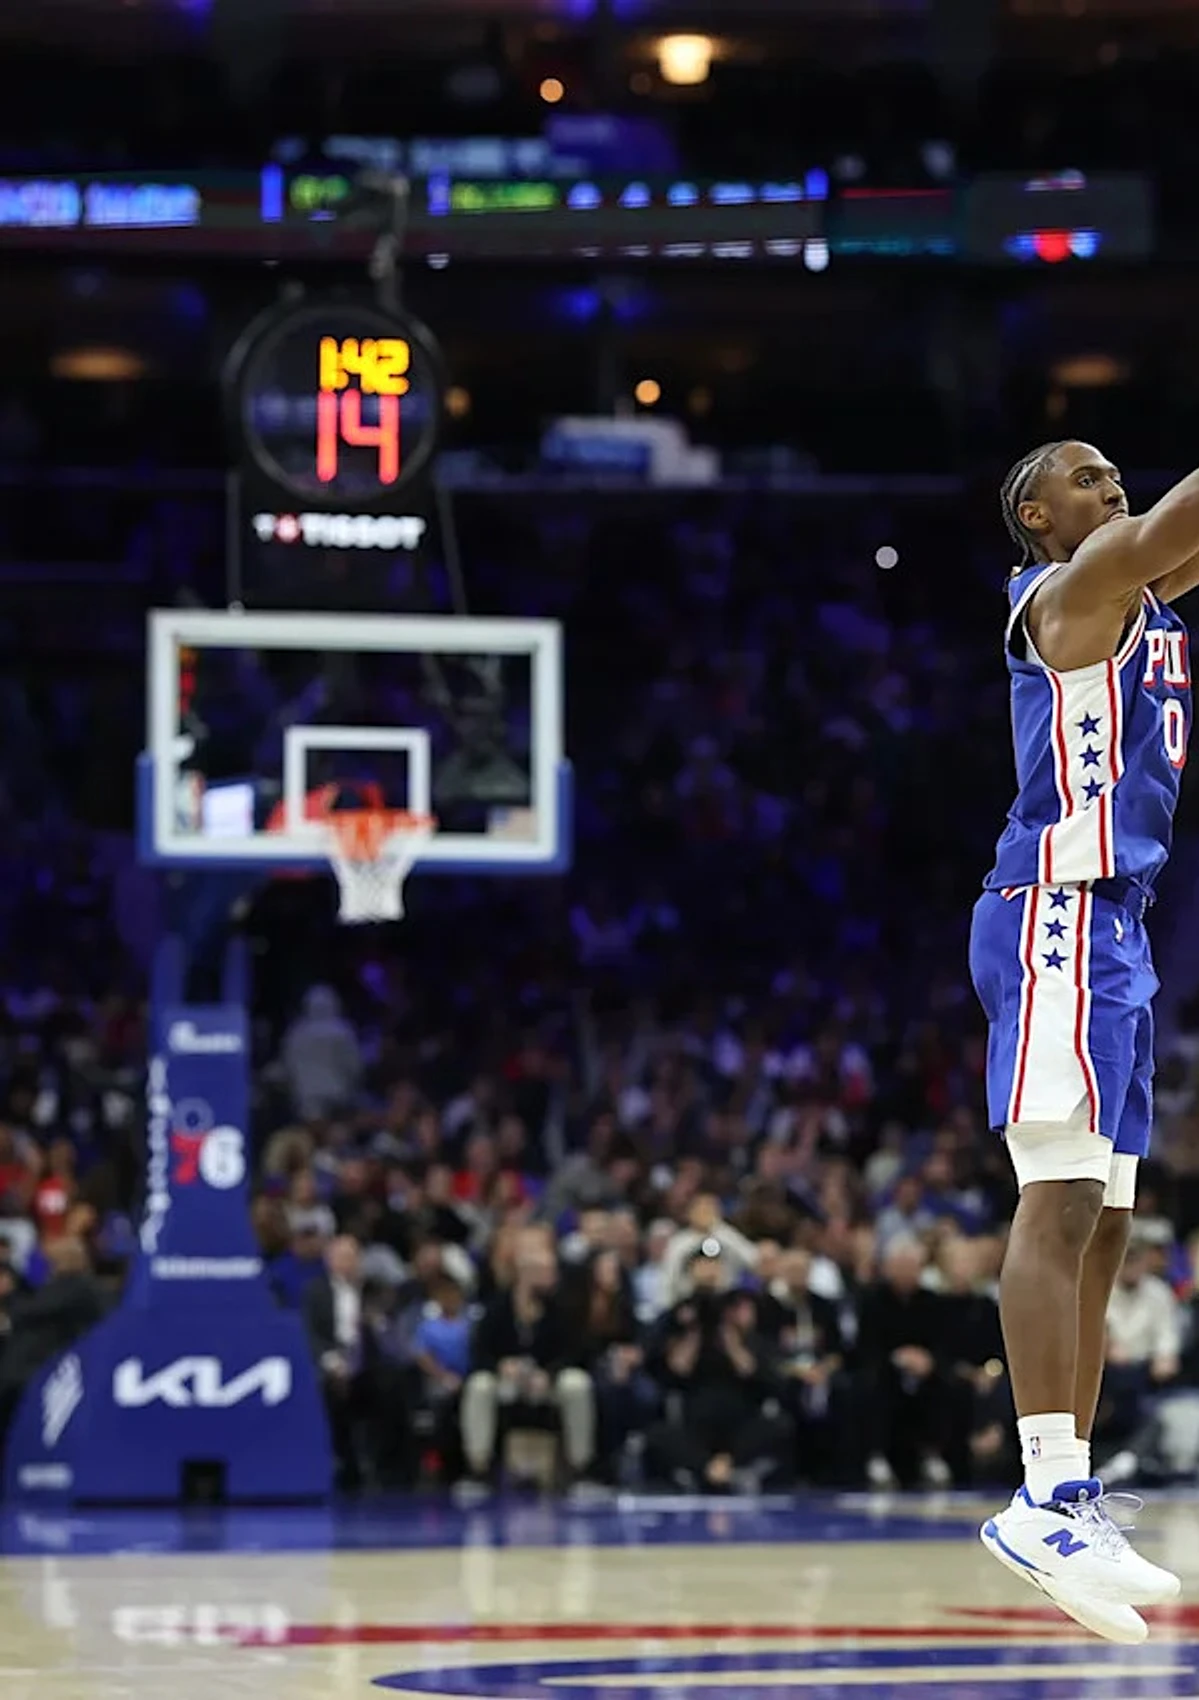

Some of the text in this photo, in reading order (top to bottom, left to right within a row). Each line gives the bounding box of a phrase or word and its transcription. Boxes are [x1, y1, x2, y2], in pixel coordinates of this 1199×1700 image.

[316, 389, 400, 485] 14
[1162, 697, 1186, 769] 0
[170, 1124, 247, 1190] 76
[113, 1356, 292, 1407] KIA
